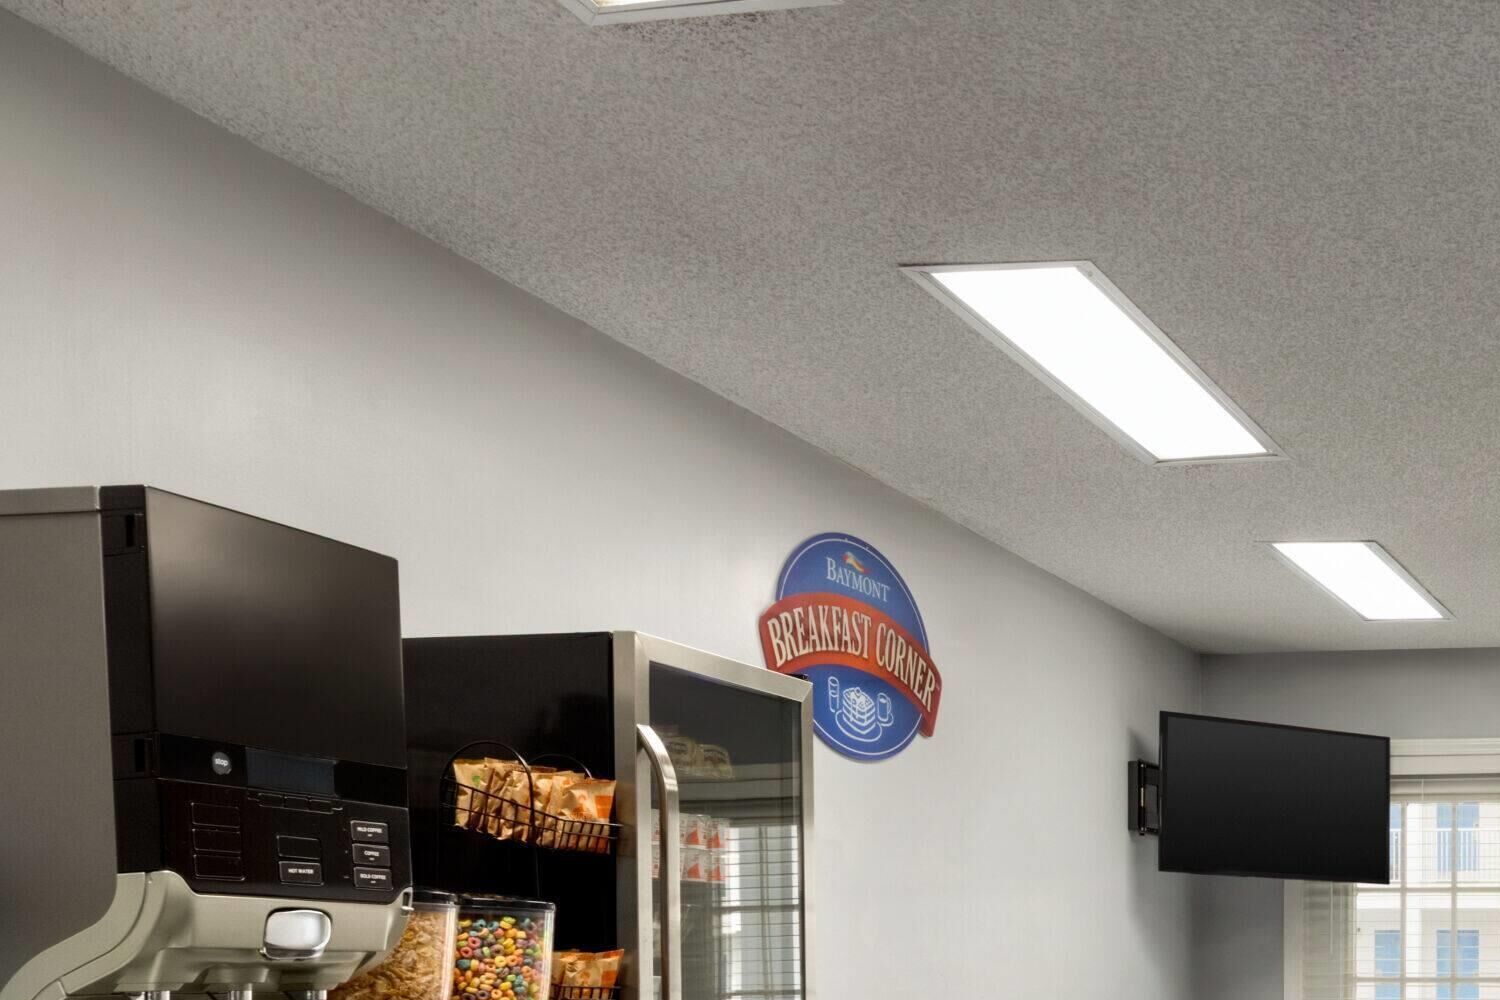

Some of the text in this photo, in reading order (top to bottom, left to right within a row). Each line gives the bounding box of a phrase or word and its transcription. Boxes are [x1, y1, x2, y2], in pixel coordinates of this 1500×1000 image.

[826, 557, 889, 602] BAYMONT
[767, 604, 938, 713] BREAKFAST CORNER
[215, 758, 229, 768] stop
